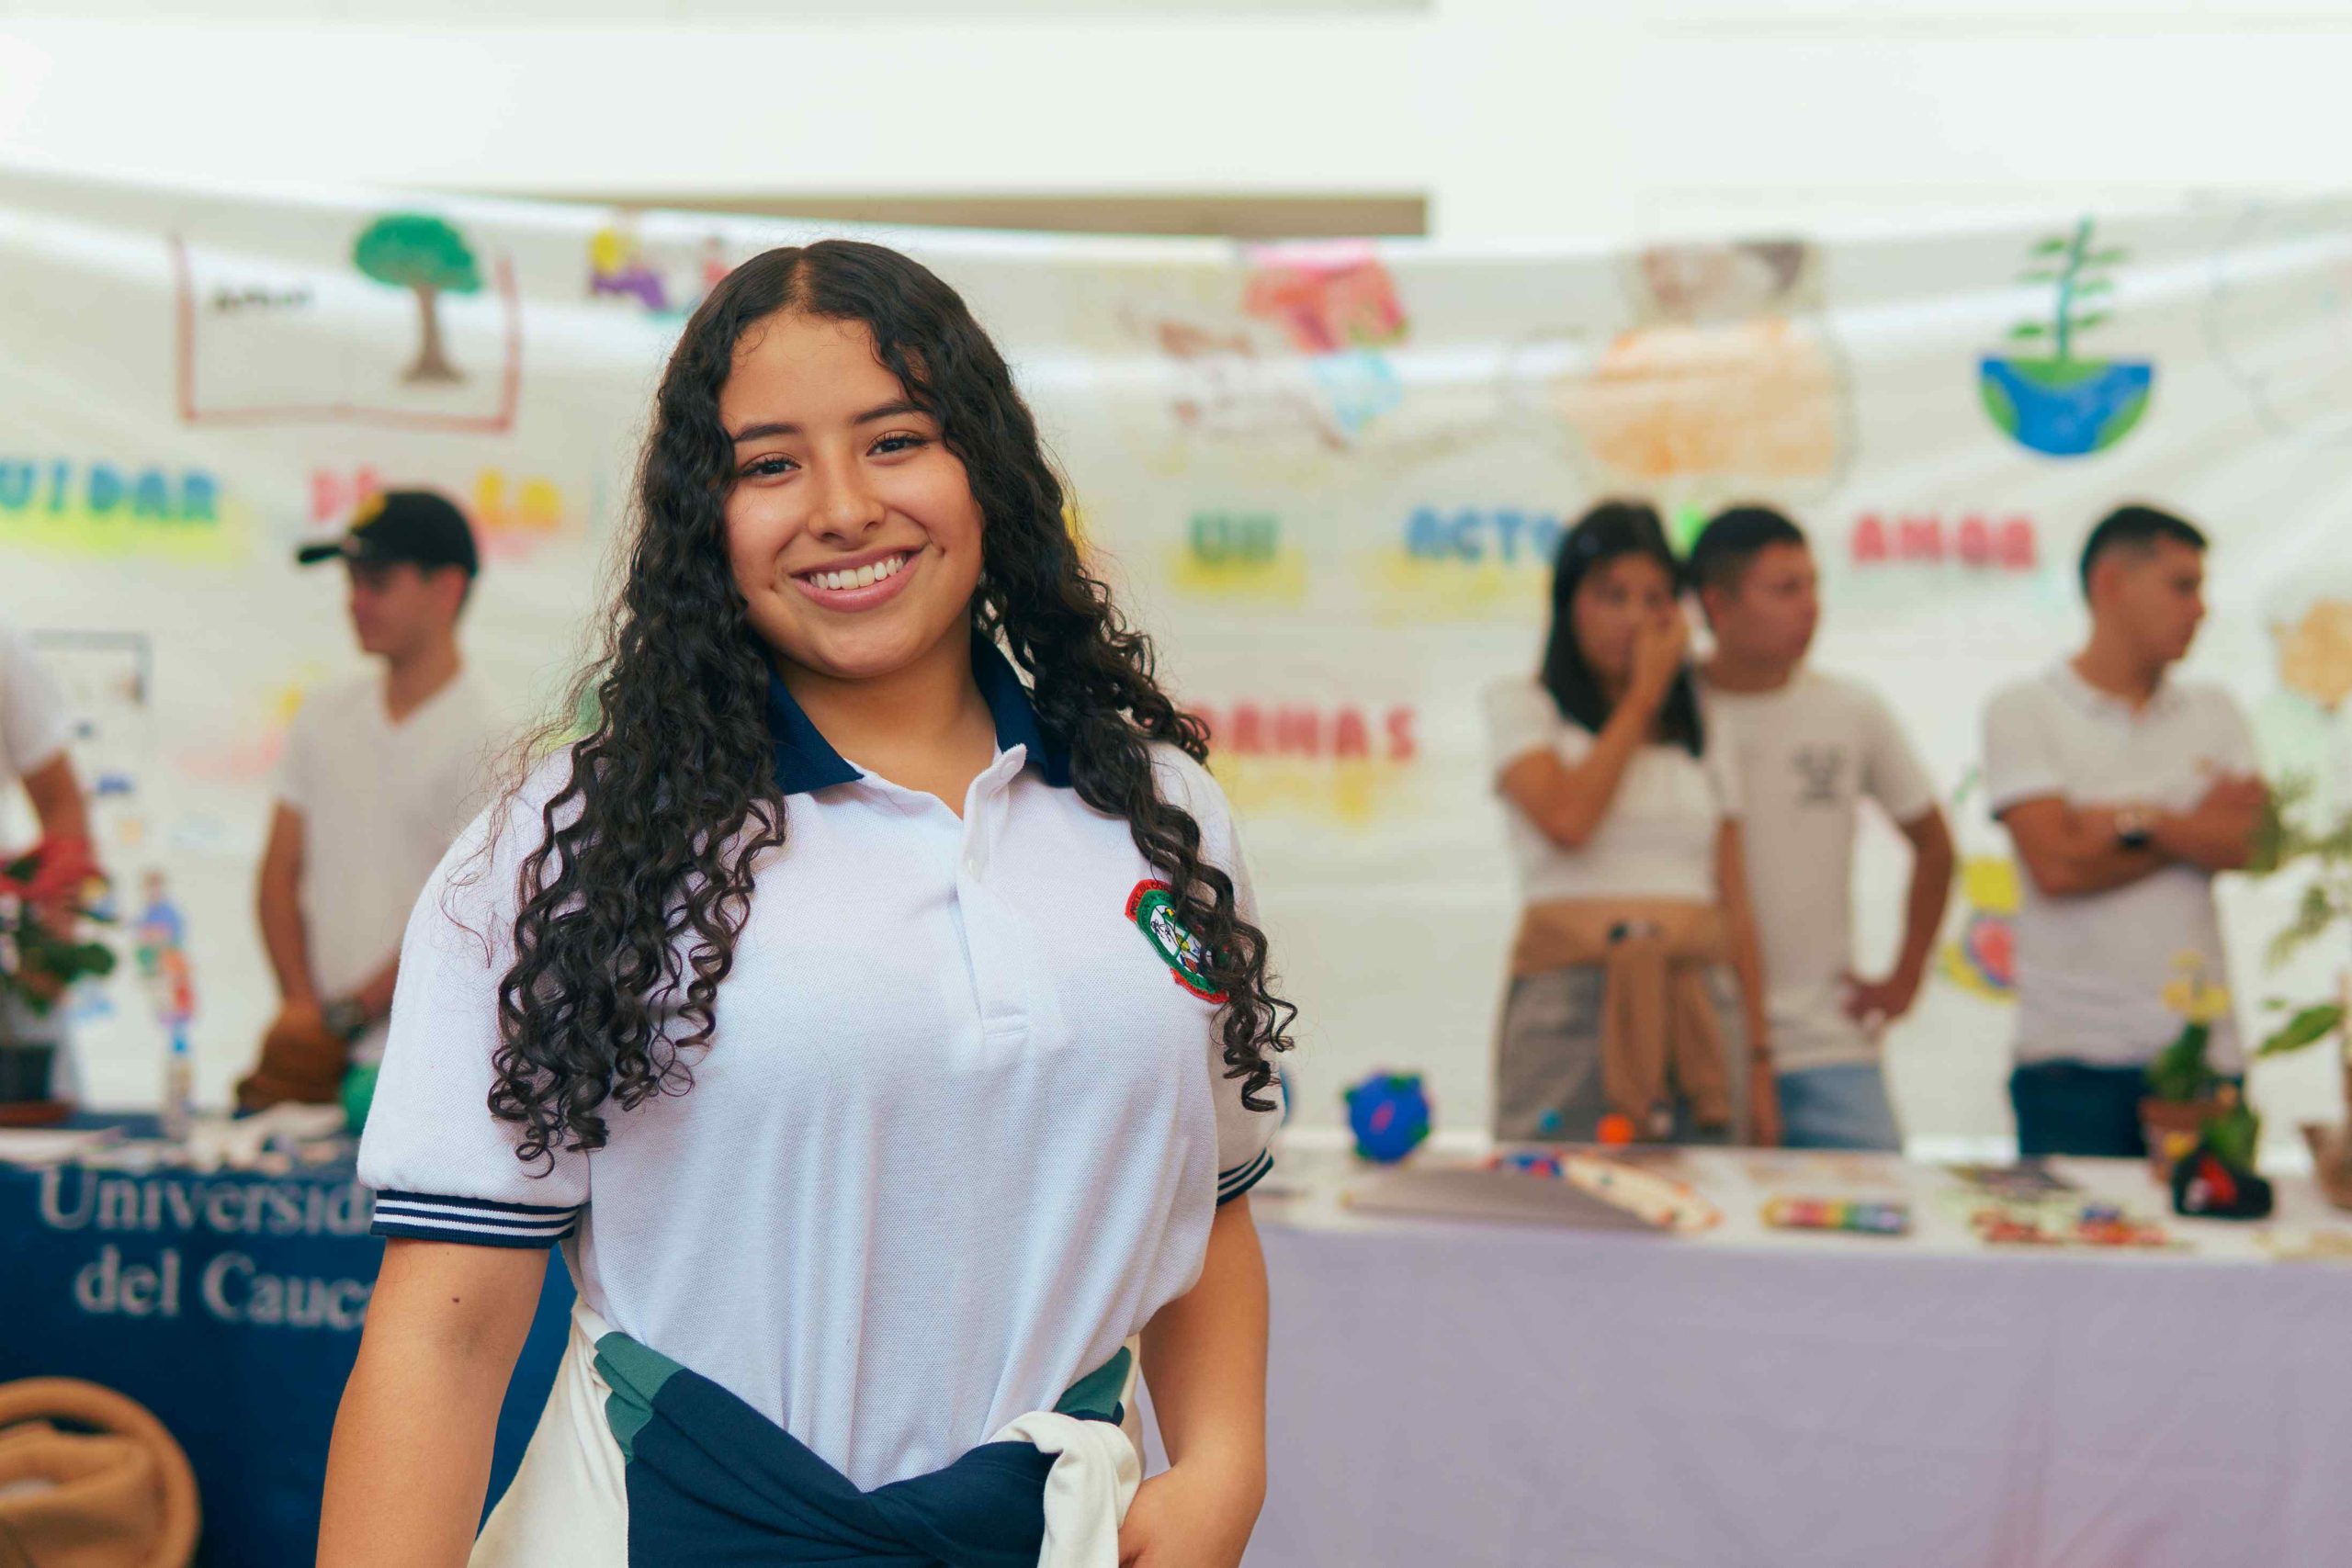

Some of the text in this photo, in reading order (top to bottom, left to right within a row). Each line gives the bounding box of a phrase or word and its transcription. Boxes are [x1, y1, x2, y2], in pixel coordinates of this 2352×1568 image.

[1849, 512, 2039, 574] AMOR
[39, 1163, 375, 1236] Universid
[74, 1244, 373, 1329] del Cauc
